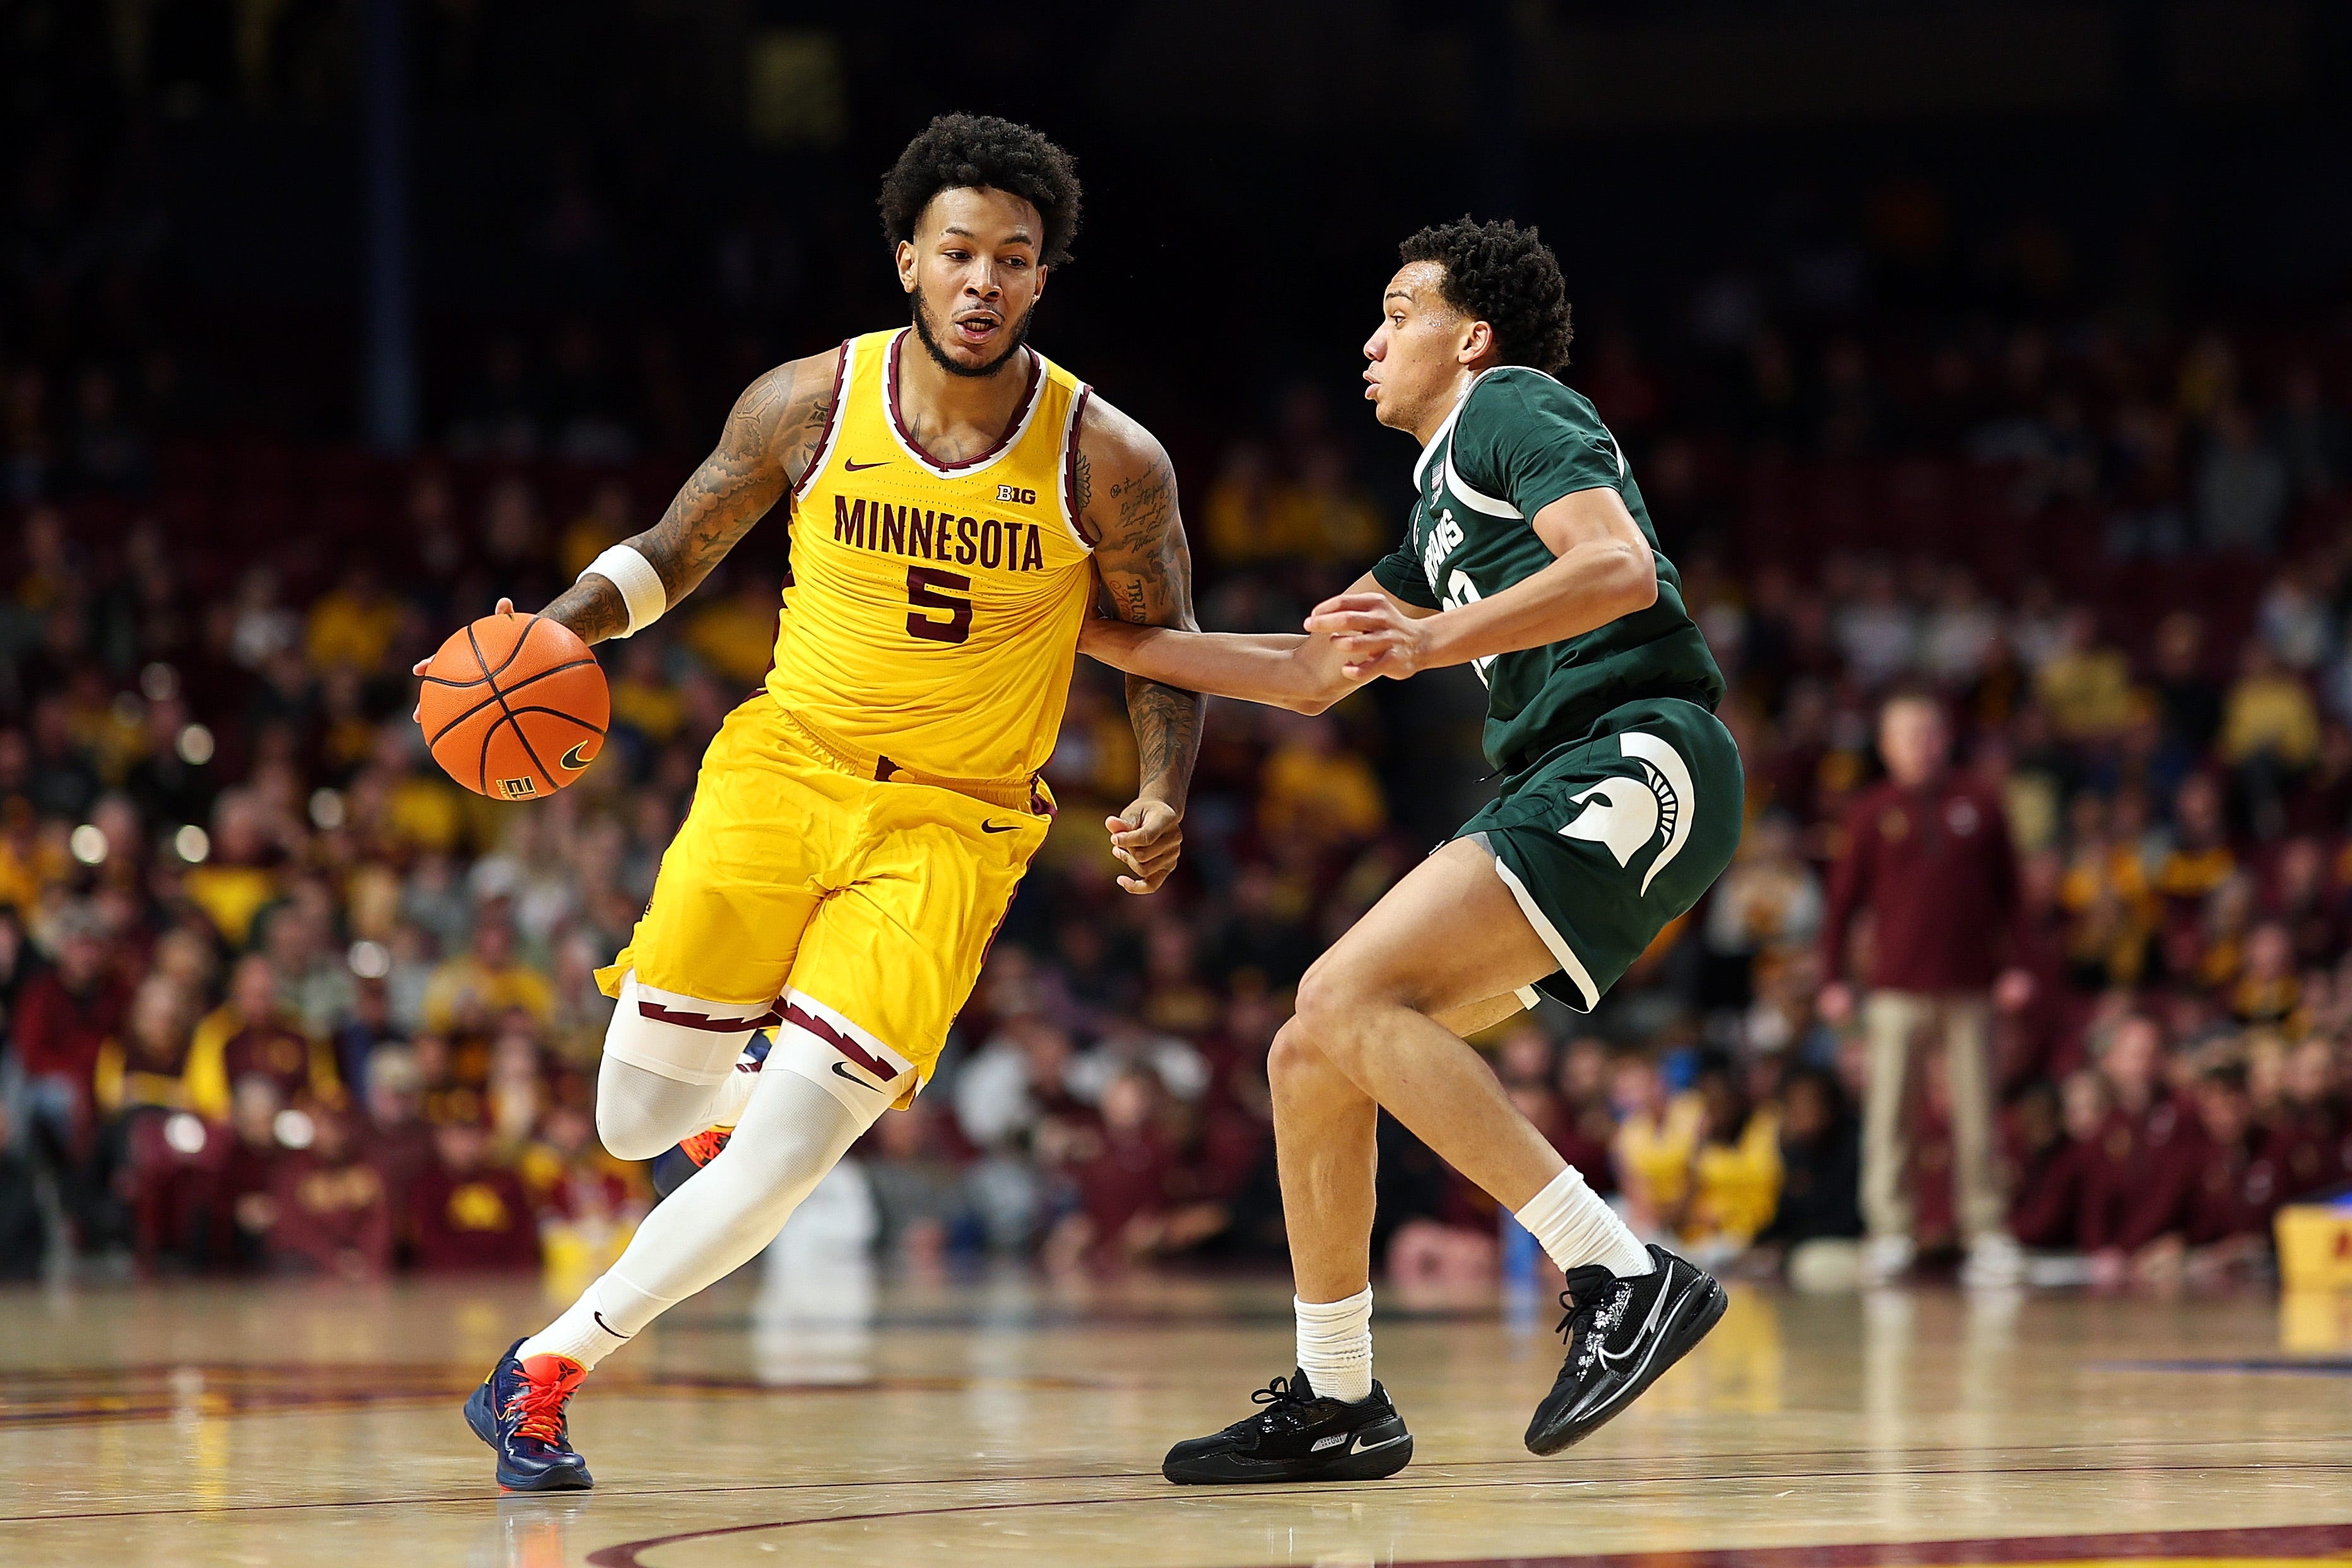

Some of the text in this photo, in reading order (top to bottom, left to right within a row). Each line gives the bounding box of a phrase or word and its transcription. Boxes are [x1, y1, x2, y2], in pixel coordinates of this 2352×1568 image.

[834, 495, 1044, 571] MINNESOTA
[906, 565, 973, 644] 5
[1126, 579, 1146, 623] TRUS
